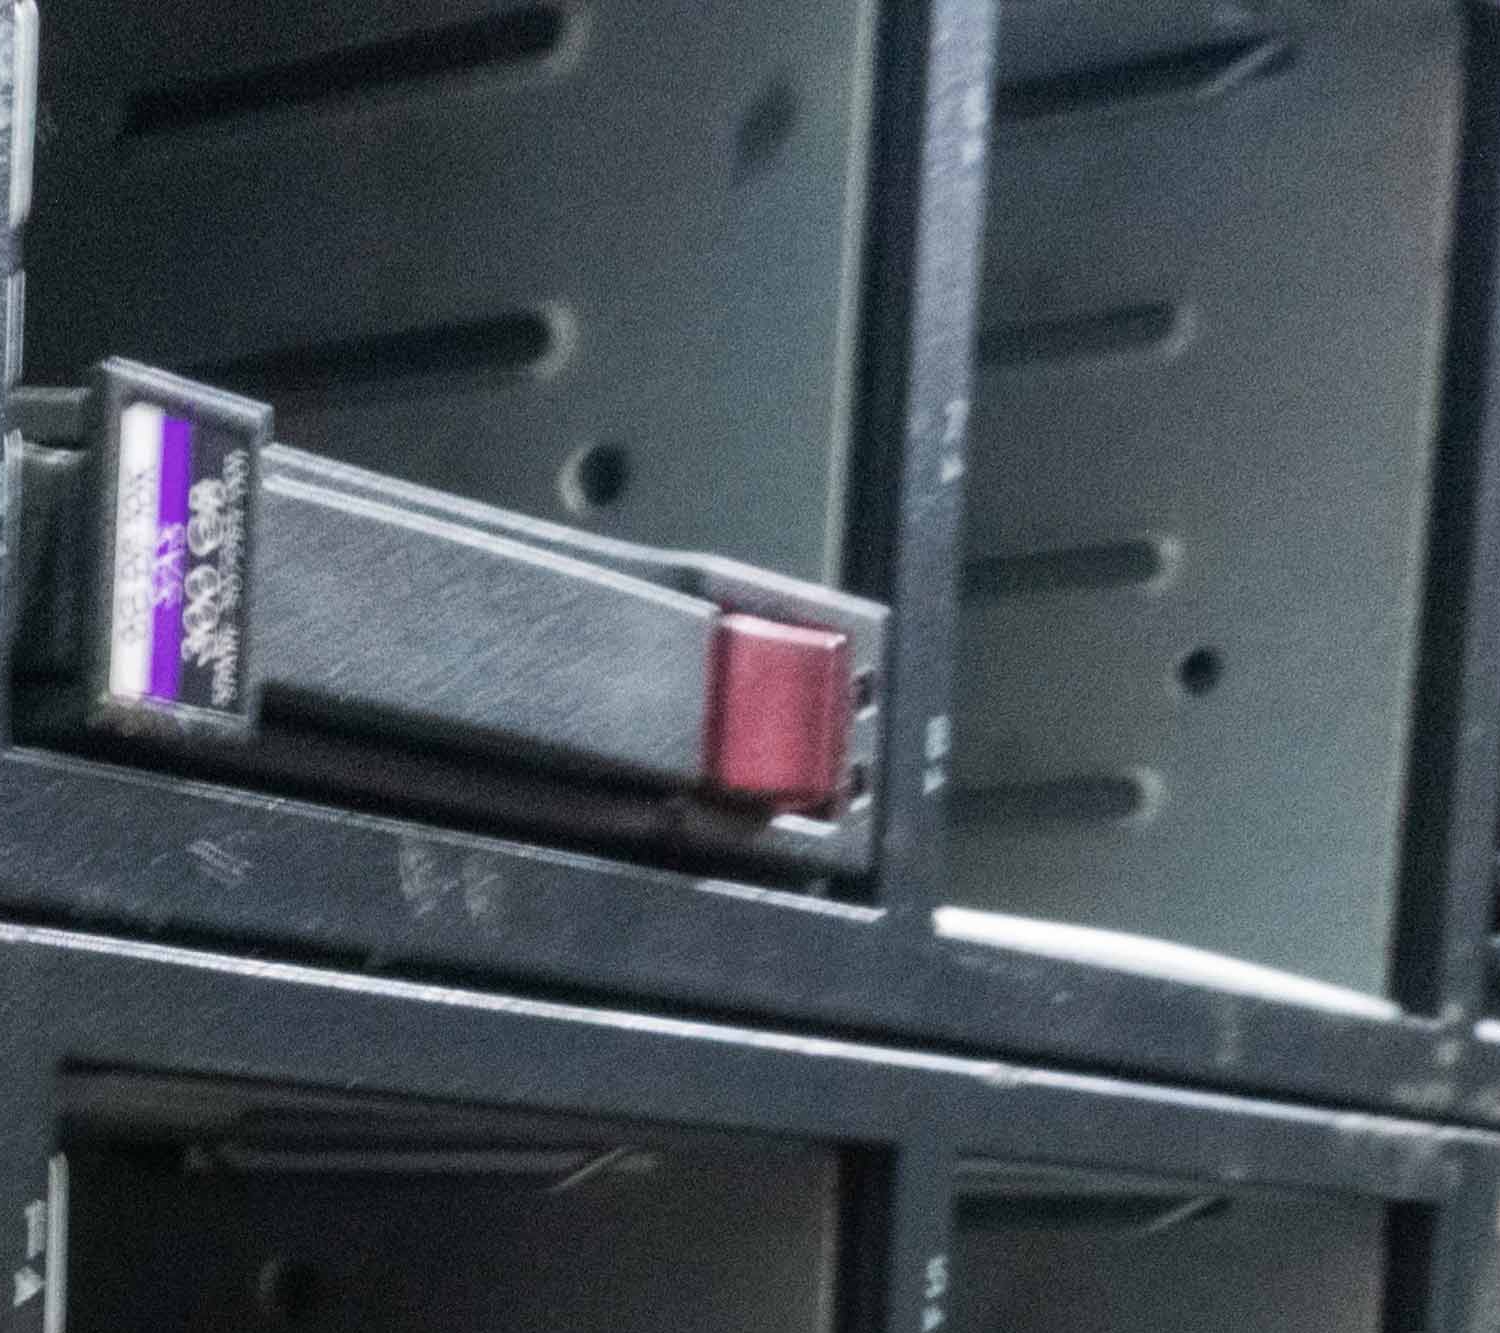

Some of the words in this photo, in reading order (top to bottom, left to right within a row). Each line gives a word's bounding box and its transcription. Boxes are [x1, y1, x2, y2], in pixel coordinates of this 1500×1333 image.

[185, 475, 227, 559] GB
[152, 519, 186, 610] SAS
[179, 562, 221, 668] 300
